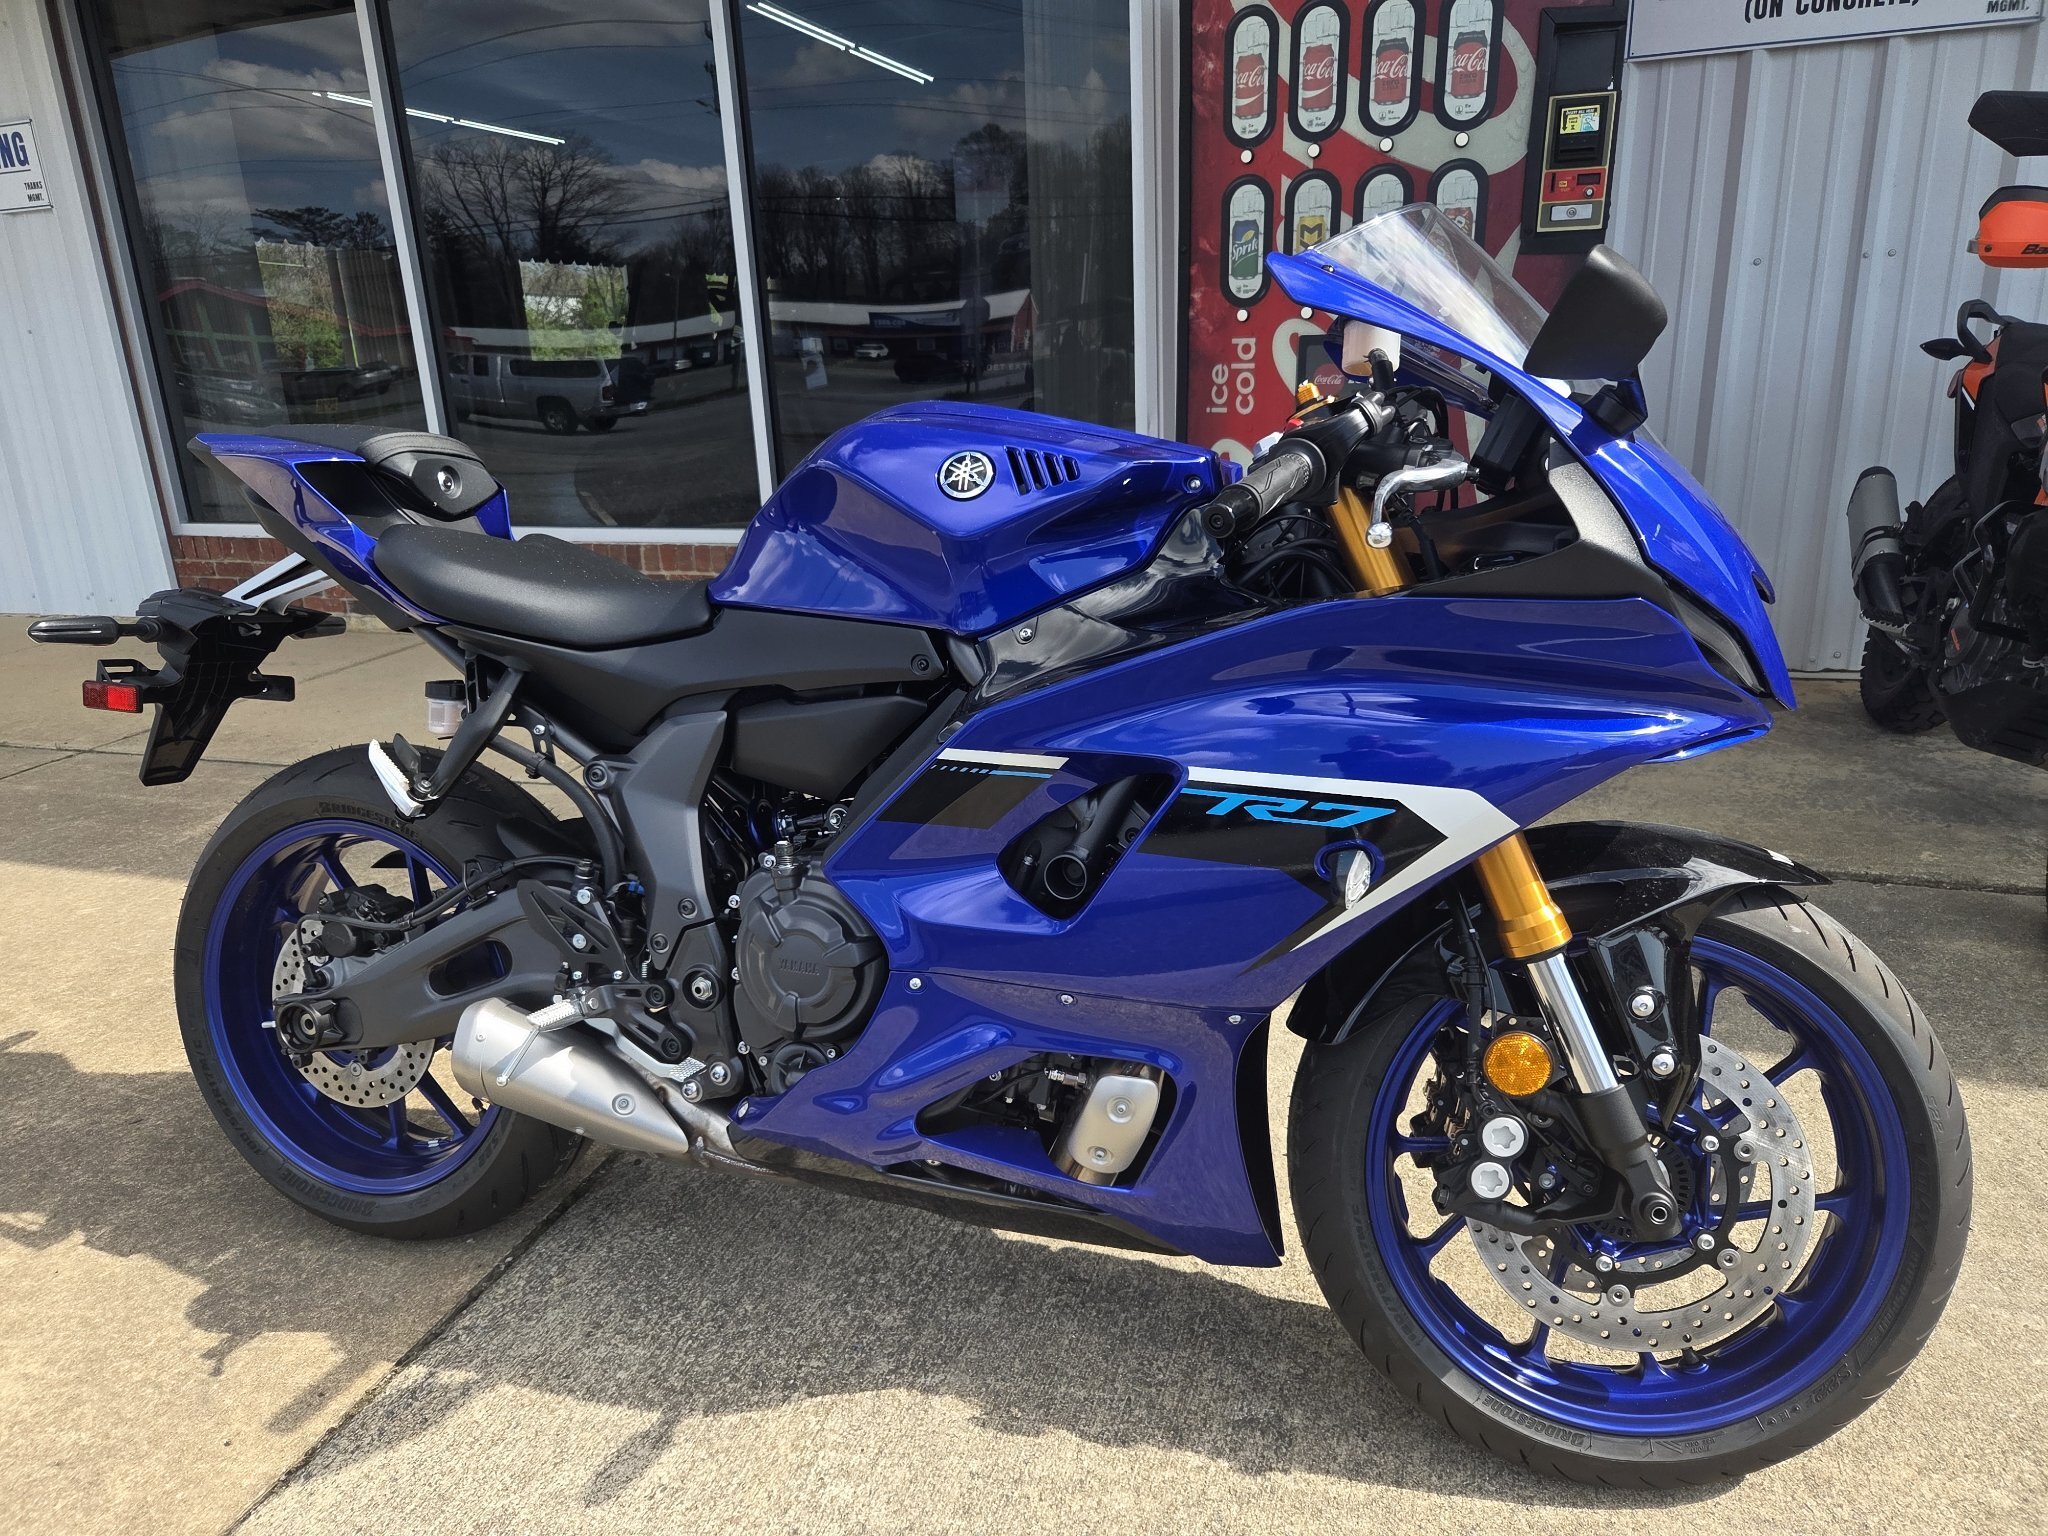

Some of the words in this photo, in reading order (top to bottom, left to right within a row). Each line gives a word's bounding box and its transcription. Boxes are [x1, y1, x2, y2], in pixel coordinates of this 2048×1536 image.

[1986, 0, 2030, 13] MGMT.
[1304, 57, 1334, 80] ca-Col
[1375, 54, 1409, 79] ca-Col
[1453, 47, 1487, 72] ca-Col
[1236, 65, 1265, 88] ca-Col
[0, 131, 30, 169] NG
[24, 181, 43, 191] THANKS
[2021, 243, 2048, 255] Ba
[1231, 337, 1256, 415] cold
[1314, 375, 1343, 385] Coca-Cola
[1206, 363, 1228, 414] ice
[1481, 1393, 1588, 1447] BRIDGESTONE
